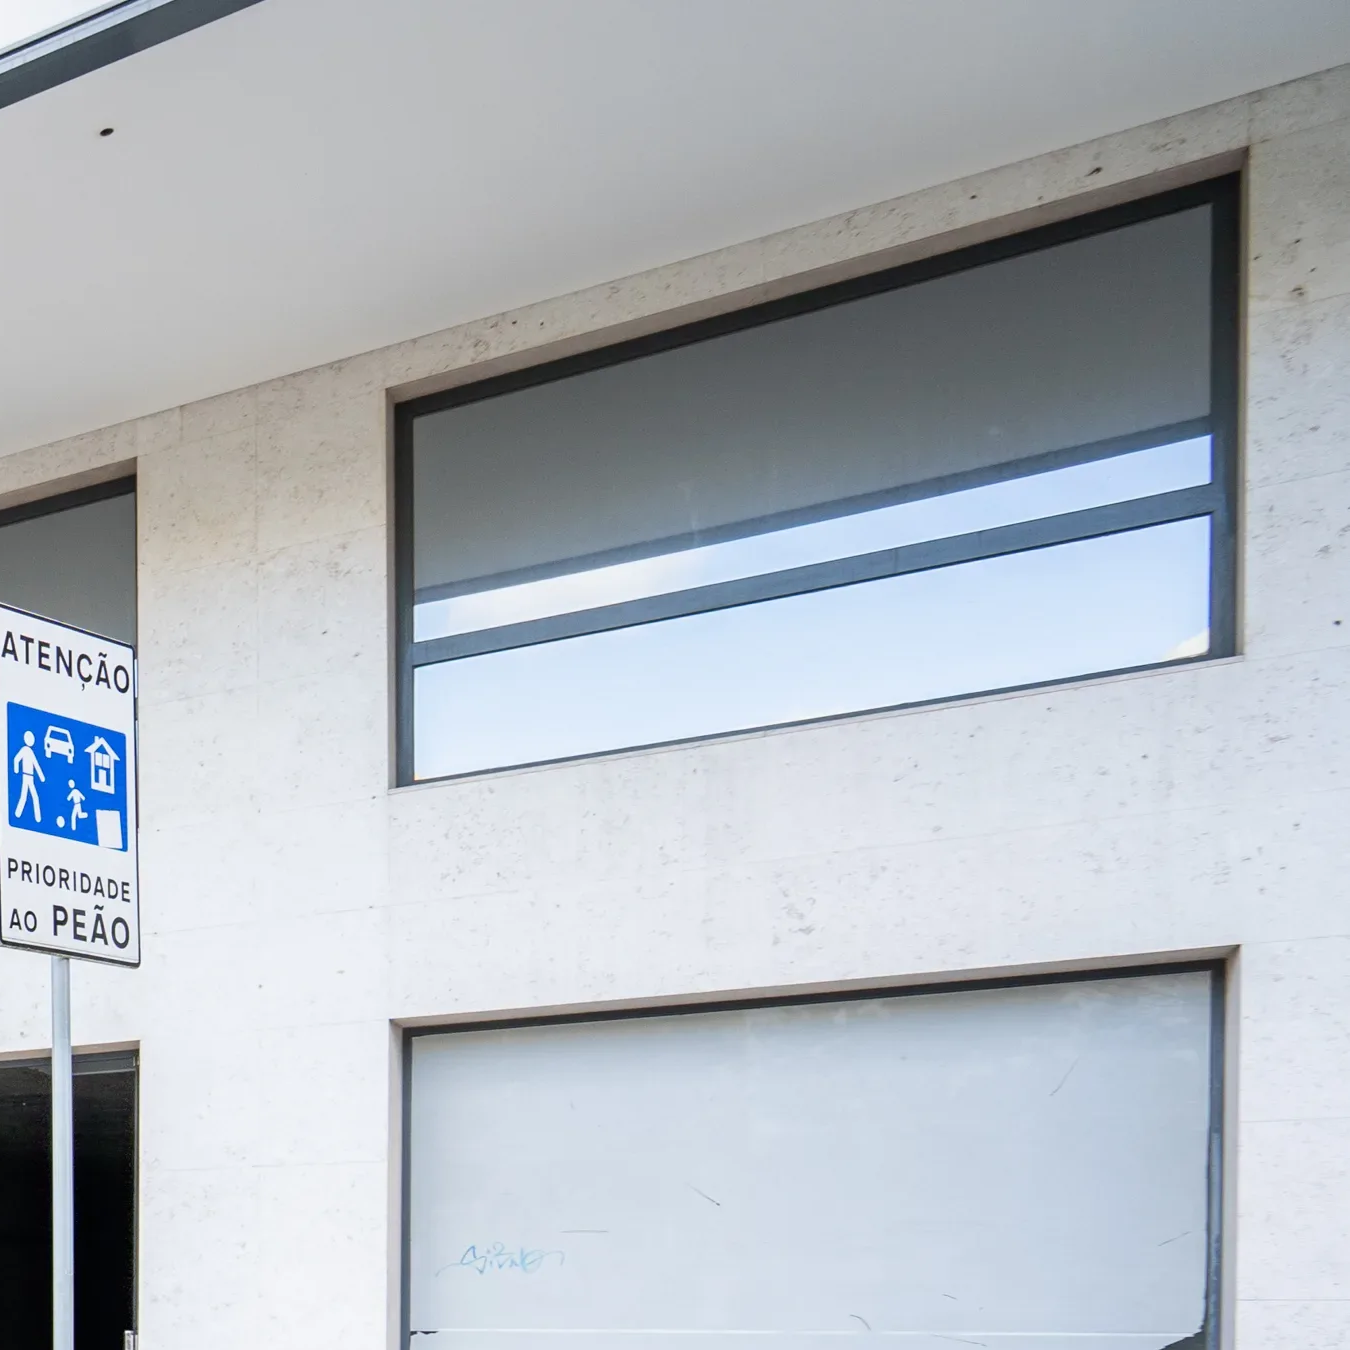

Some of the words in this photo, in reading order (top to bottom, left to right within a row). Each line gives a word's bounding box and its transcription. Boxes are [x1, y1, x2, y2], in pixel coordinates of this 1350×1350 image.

[1, 631, 130, 694] ATENÇÃO
[7, 857, 131, 903] PRIORIDADE
[9, 908, 38, 933] AO
[52, 904, 130, 950] PEÃO
